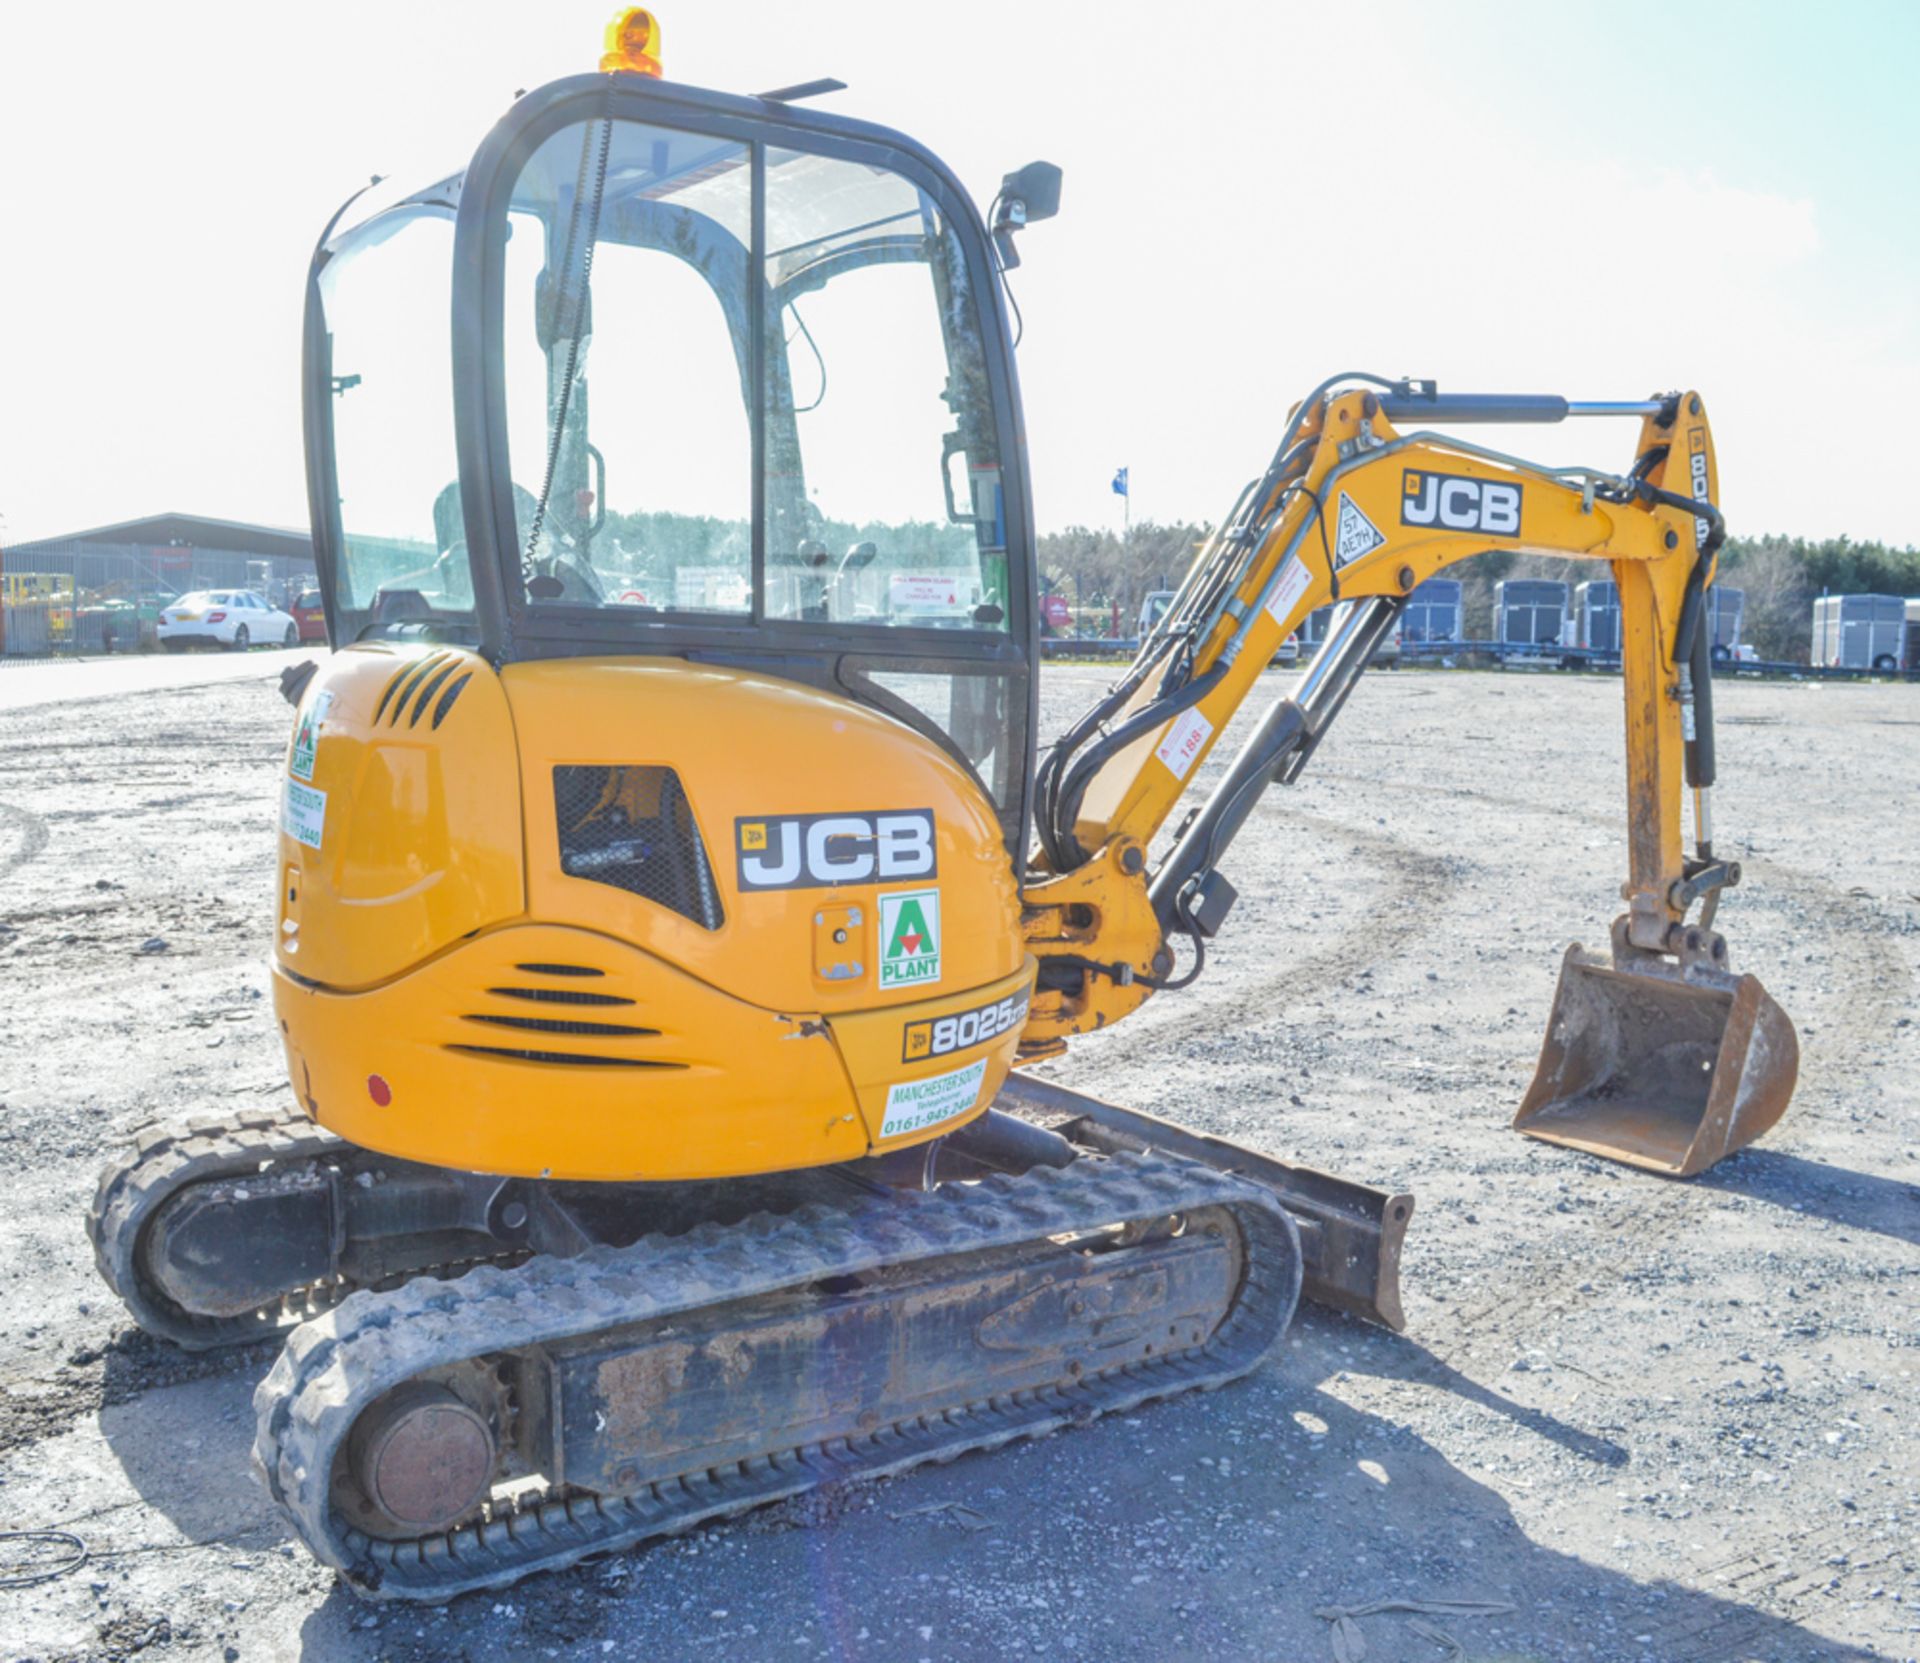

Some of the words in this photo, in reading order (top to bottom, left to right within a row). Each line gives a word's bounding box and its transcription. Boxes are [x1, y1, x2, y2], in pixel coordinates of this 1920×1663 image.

[1403, 475, 1520, 533] JCB
[1181, 729, 1202, 758] 188
[742, 815, 934, 885] JCB
[886, 899, 935, 959] A
[882, 958, 939, 982] PLANT
[892, 1073, 957, 1105] MANCHESTER
[956, 1063, 984, 1090] SOUTH
[884, 1106, 949, 1135] 0161-945
